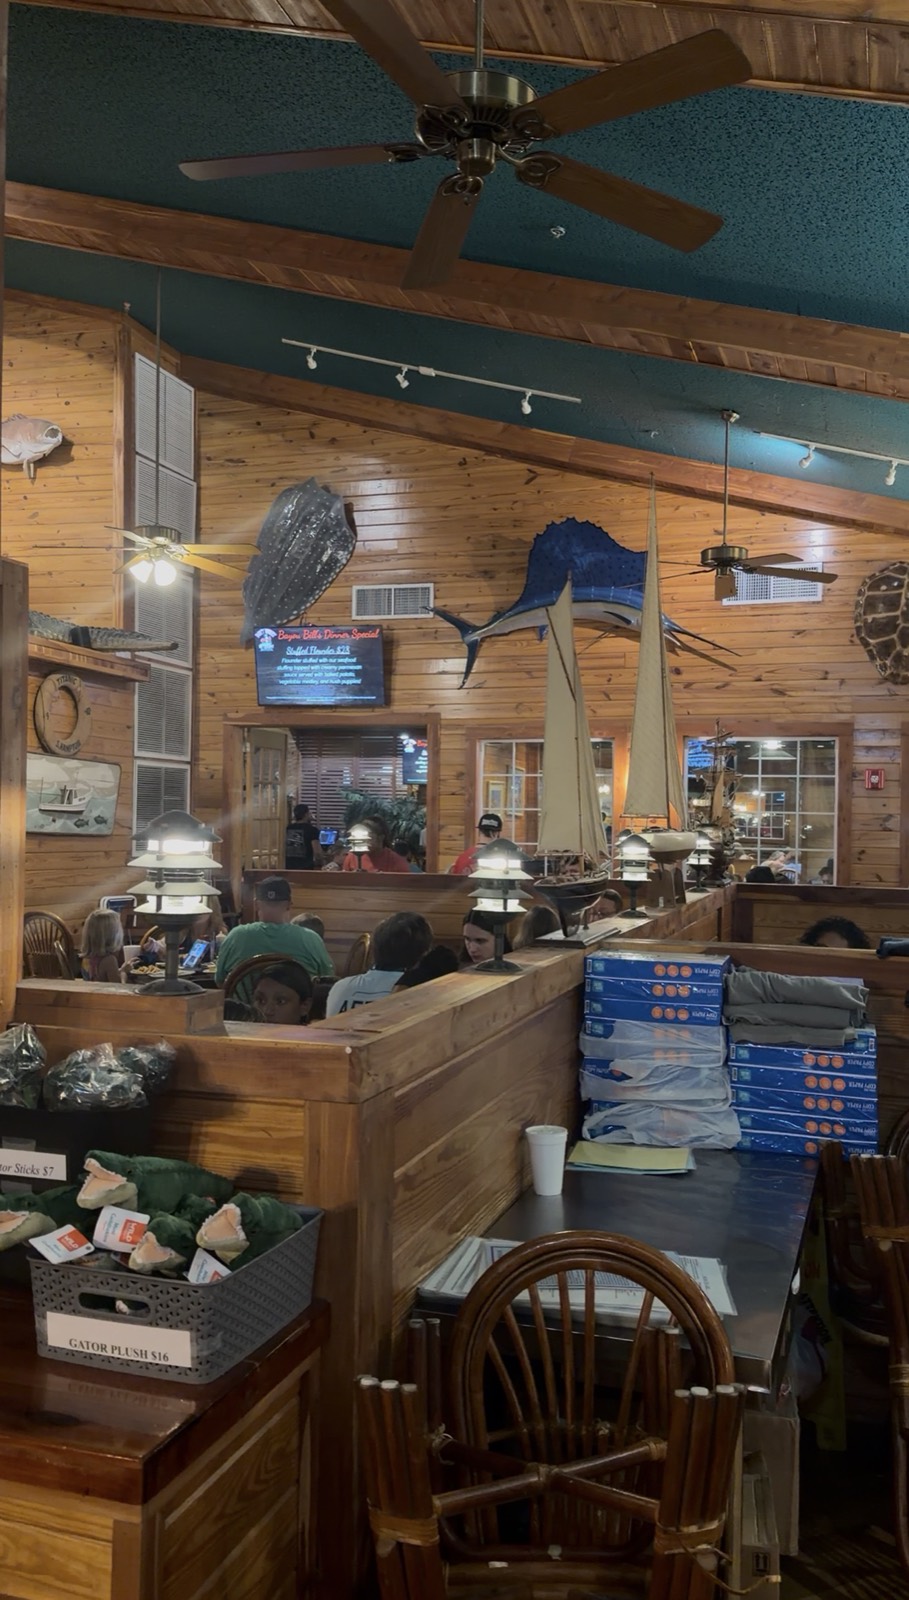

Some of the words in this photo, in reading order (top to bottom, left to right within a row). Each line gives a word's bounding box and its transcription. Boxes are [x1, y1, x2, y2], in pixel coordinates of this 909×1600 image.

[324, 629, 350, 640] Dinner
[351, 628, 380, 640] Special
[286, 645, 309, 655] Stuffed
[56, 675, 78, 686] TITANIC
[14, 1163, 41, 1176] Sticks
[42, 1166, 55, 1177] $7
[69, 1338, 108, 1354] GATOR
[111, 1344, 148, 1360] PLUSH
[151, 1350, 170, 1362] $16
